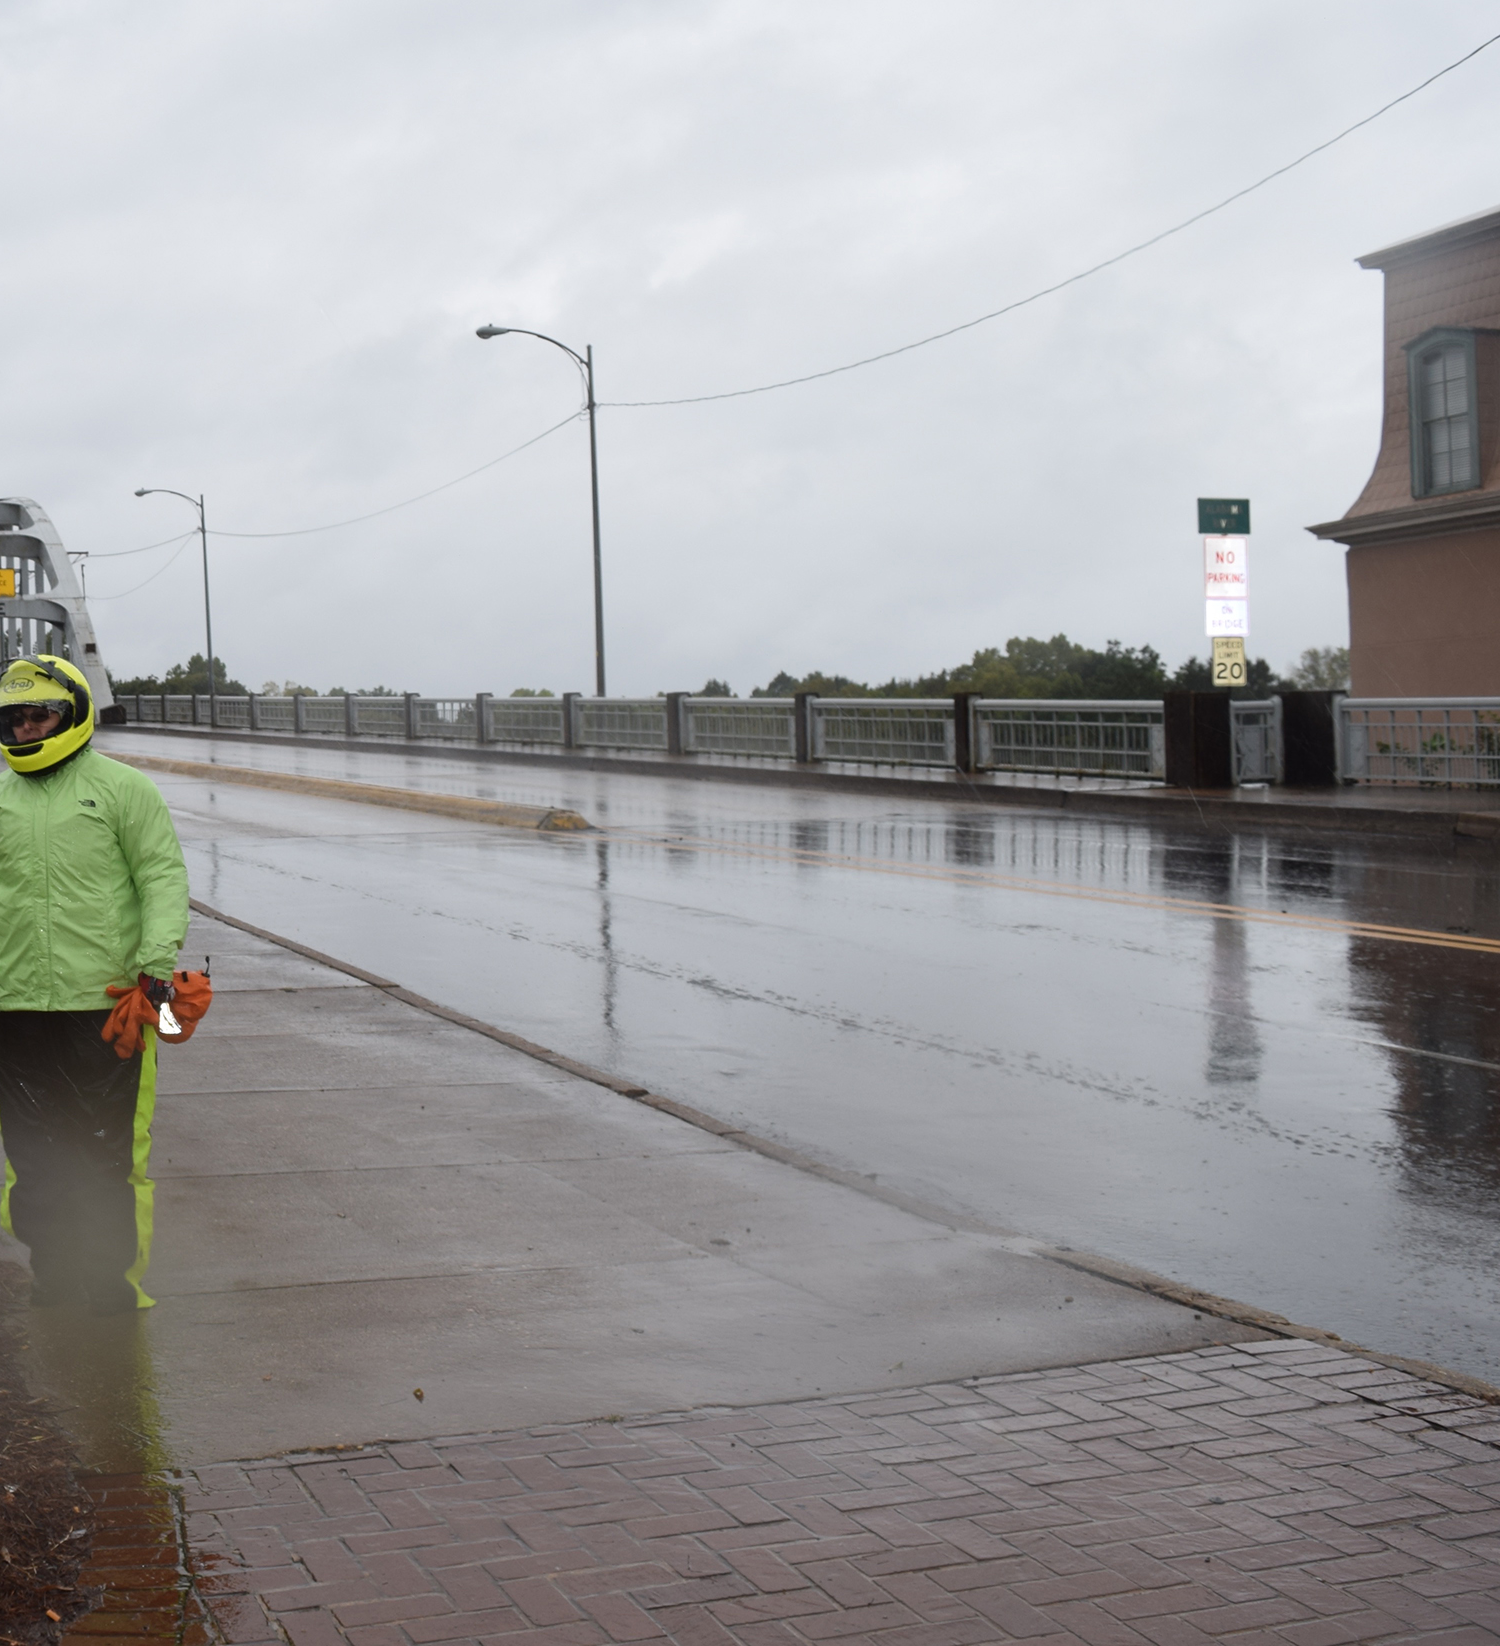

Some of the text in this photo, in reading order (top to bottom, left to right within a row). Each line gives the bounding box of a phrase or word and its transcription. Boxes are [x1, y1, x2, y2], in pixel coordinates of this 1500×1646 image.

[1215, 551, 1236, 565] NO
[1206, 573, 1246, 584] PARKING
[1215, 641, 1243, 649] SPEED
[1218, 651, 1240, 659] LIMIT
[1216, 662, 1244, 680] 20
